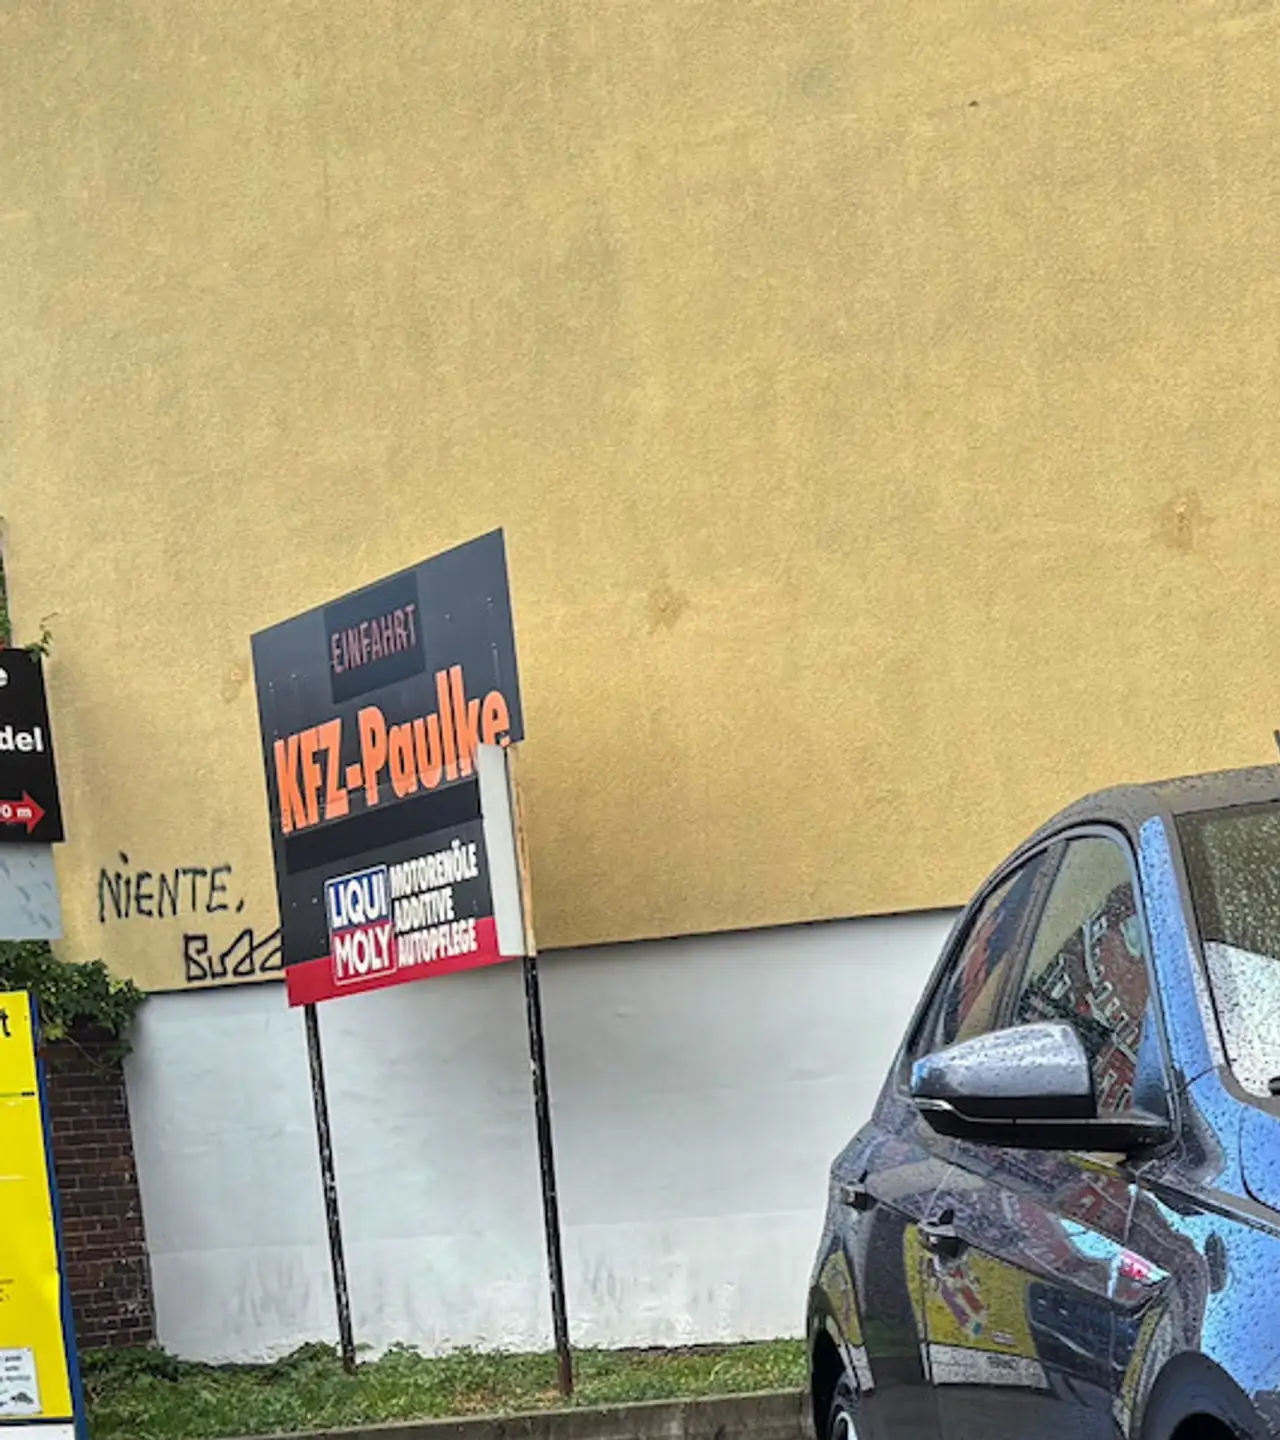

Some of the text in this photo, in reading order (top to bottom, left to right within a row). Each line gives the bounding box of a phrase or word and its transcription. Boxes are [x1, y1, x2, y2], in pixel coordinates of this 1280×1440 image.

[331, 604, 416, 673] EINFAHRT
[274, 664, 510, 834] KFZ-Paulke
[389, 839, 478, 898] MOTORENÖLE
[329, 873, 388, 928] LIQUI
[393, 886, 455, 932] ADDITIVE
[334, 924, 392, 978] MOLY
[398, 917, 478, 967] AUTOPFLEGE
